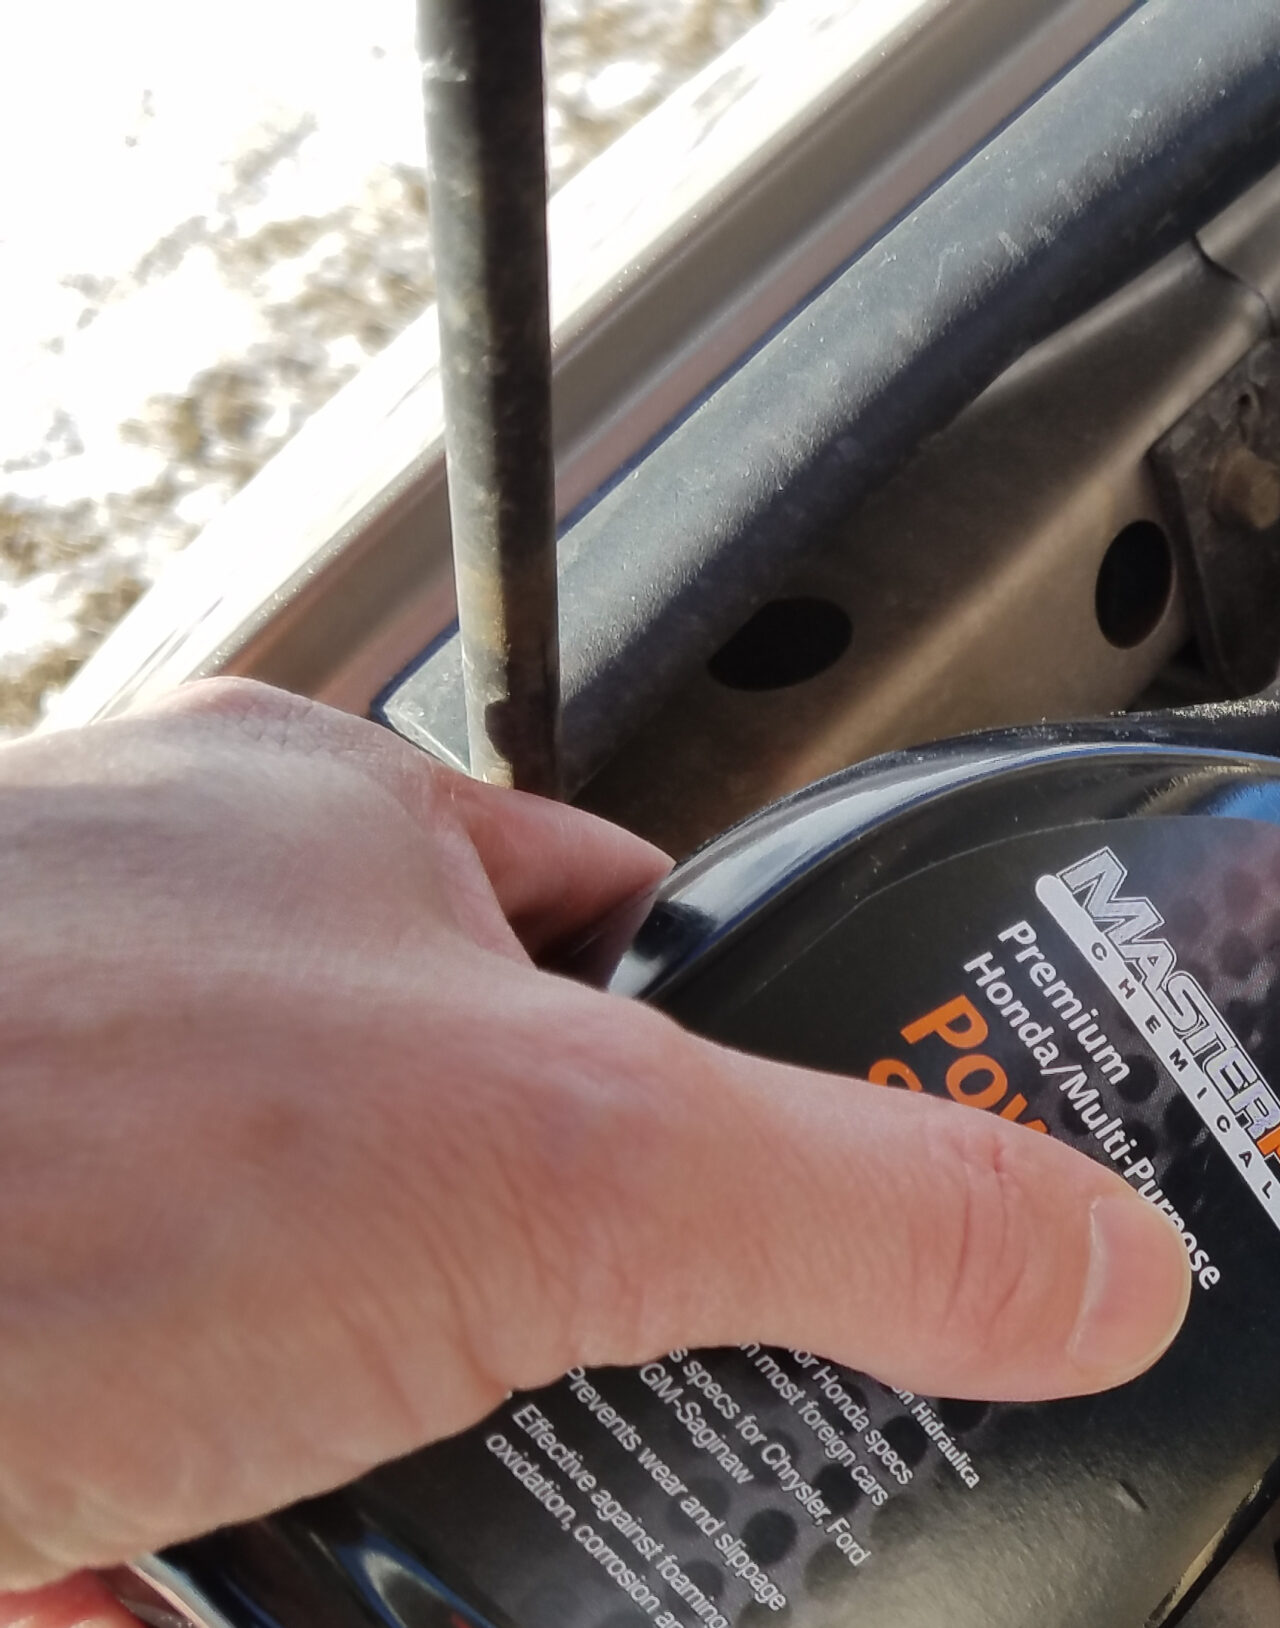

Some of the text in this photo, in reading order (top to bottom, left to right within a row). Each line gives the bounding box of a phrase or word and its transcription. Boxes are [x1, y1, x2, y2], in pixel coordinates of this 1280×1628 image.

[998, 920, 1131, 1086] Premium
[512, 1403, 597, 1492] Effective
[591, 1489, 665, 1562] against
[639, 1362, 755, 1485] GM-Saginaw
[683, 1361, 872, 1567] specs for Chrysler, Ford
[755, 1354, 806, 1406] most
[798, 1400, 856, 1466] foreign
[851, 1465, 888, 1506] cars
[788, 1348, 819, 1368] or
[812, 1365, 870, 1432] Honda
[864, 1429, 913, 1485] specs
[911, 1401, 980, 1488] Hidráulica
[486, 1433, 577, 1531] oxidation,
[573, 1525, 661, 1614] corrosion
[637, 1447, 689, 1497] wear
[680, 1496, 726, 1538] and
[715, 1532, 786, 1612] slippage
